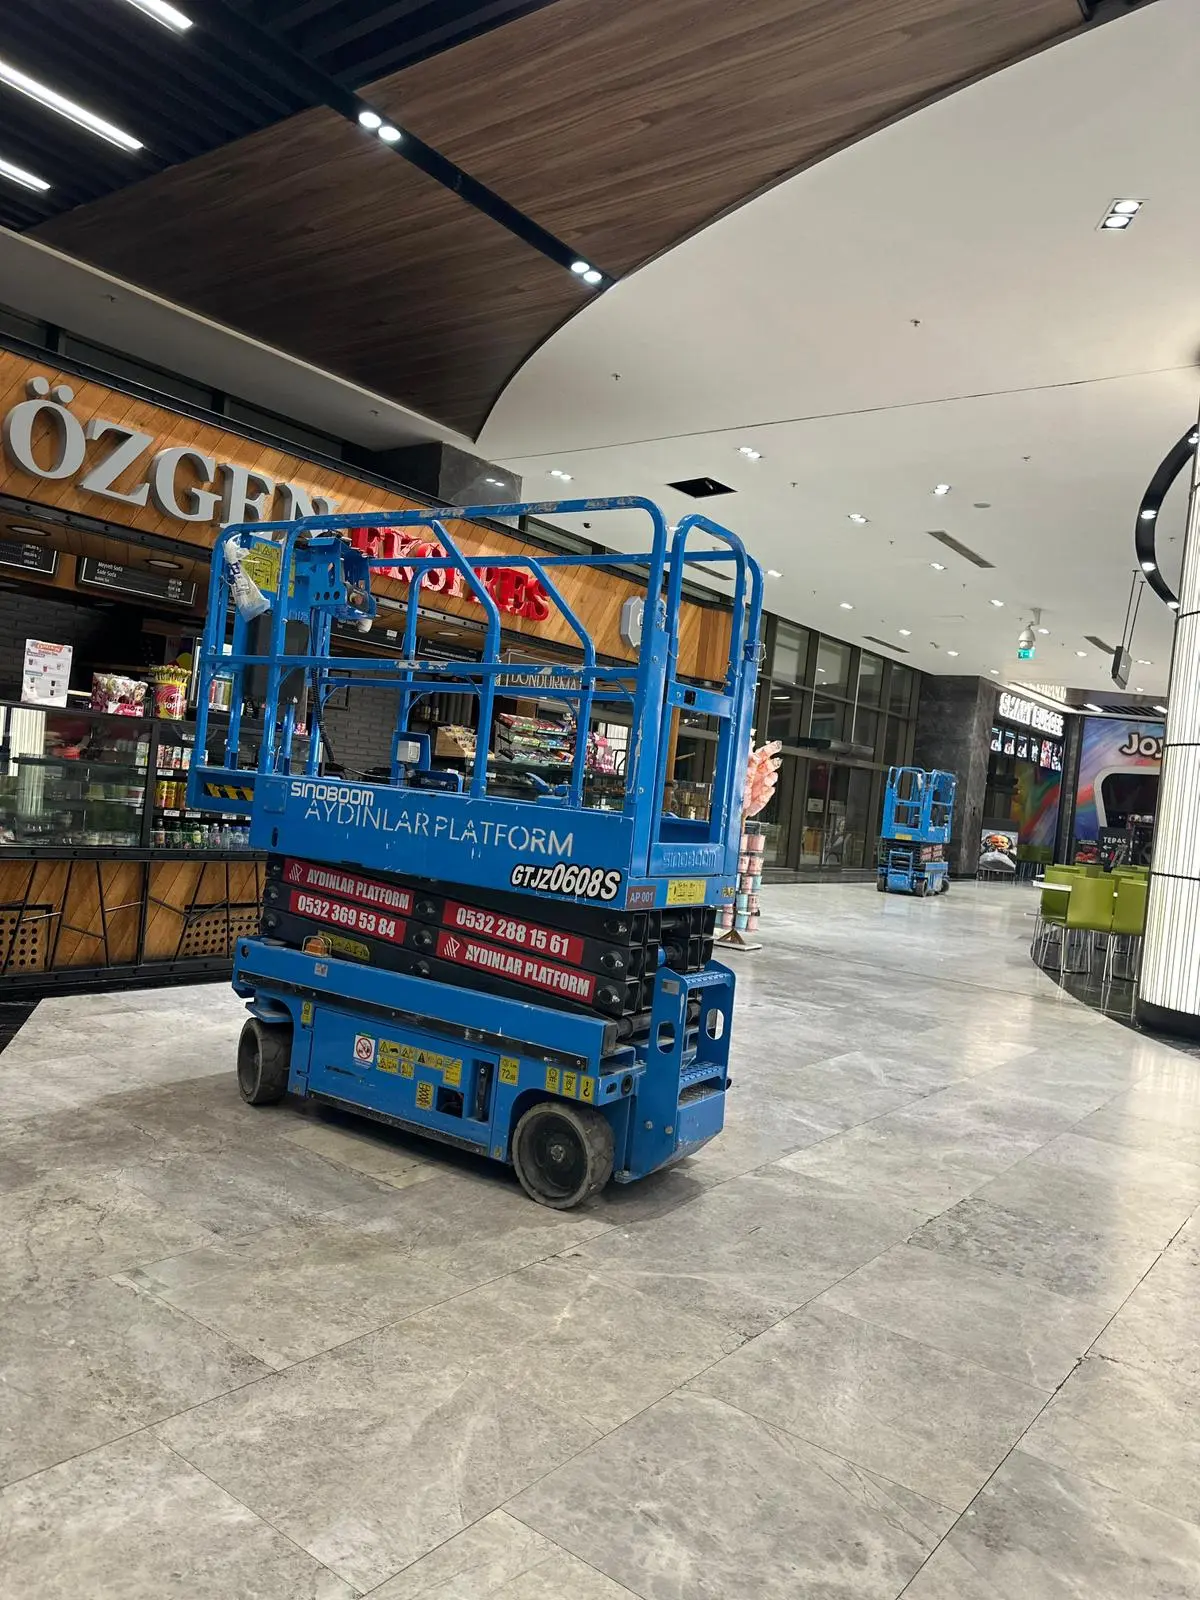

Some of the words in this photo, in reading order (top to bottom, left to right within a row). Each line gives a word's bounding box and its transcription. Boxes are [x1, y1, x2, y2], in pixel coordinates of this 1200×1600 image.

[304, 799, 430, 837] AYDINLAR
[433, 815, 574, 857] PLATFORM
[306, 868, 355, 895] AYDINLAR
[355, 880, 410, 910] PLATFORM
[510, 863, 622, 901] GTJZ0608S
[297, 895, 330, 918] 0532
[331, 904, 357, 926] 369
[358, 911, 376, 932] 53
[377, 917, 396, 938] 84
[456, 907, 495, 934] 0532
[495, 918, 527, 943] 288
[529, 928, 548, 950] 15
[549, 934, 570, 957] 61
[464, 944, 523, 976] AYDINLAR
[523, 961, 590, 998] PLATFORM
